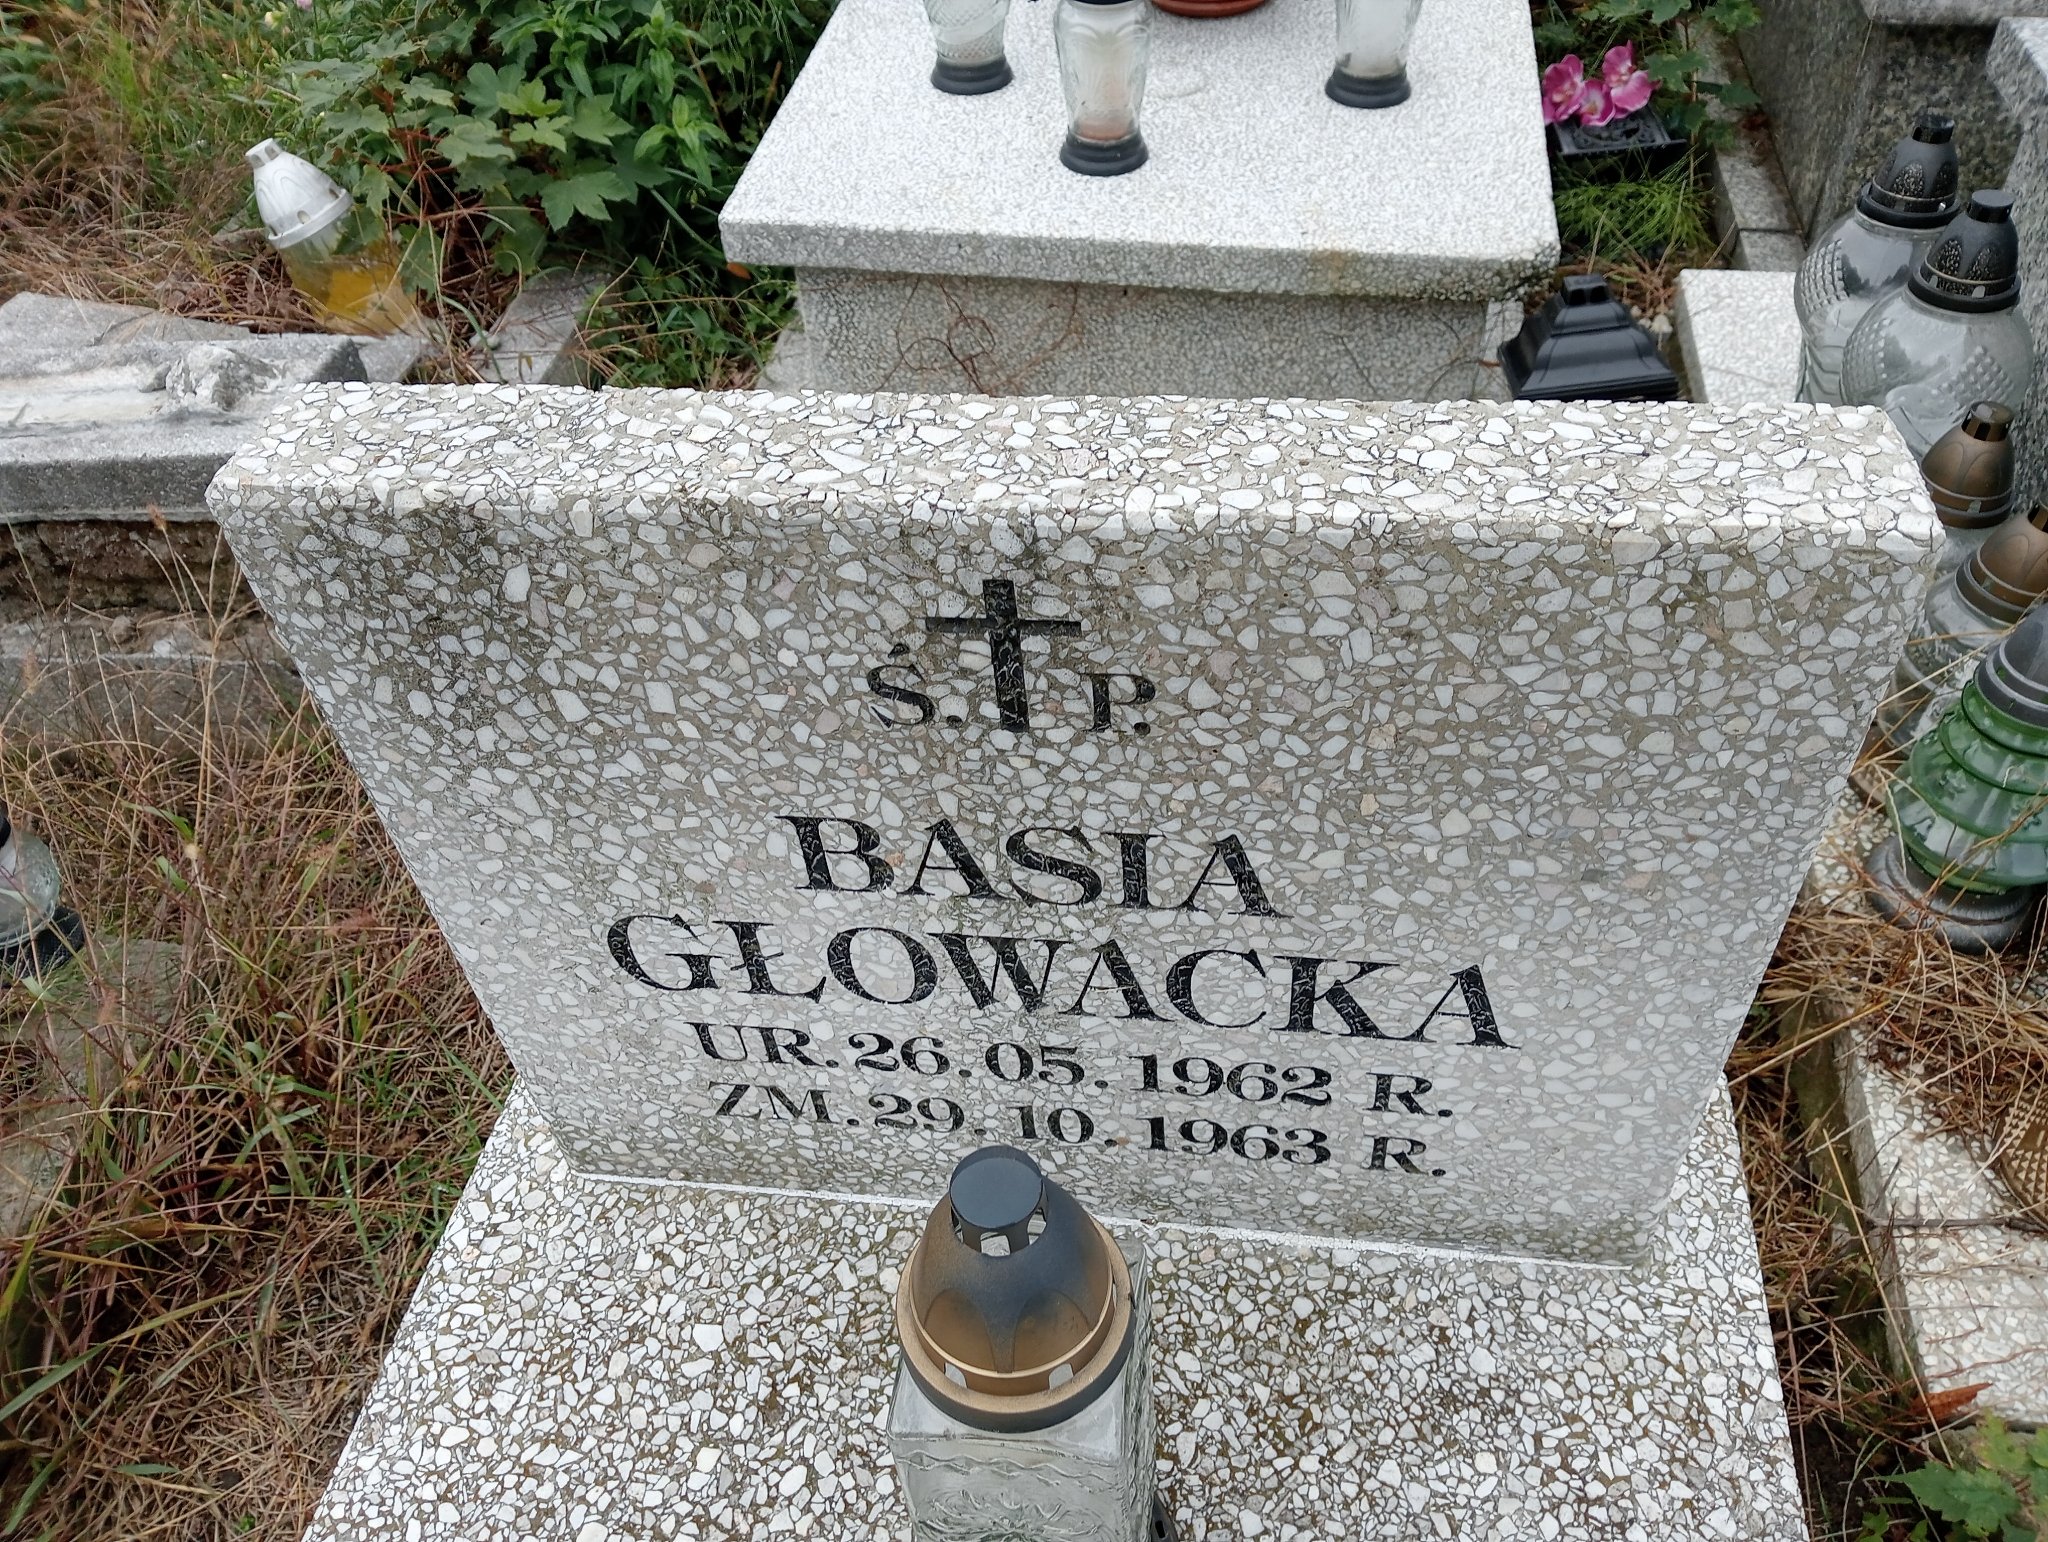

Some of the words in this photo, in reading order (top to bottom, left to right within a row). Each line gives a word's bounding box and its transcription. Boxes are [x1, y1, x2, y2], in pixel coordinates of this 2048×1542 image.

[1079, 671, 1156, 735] P.
[775, 814, 1294, 919] BASIA
[607, 914, 1522, 1050] GŁOWACKA
[1362, 1072, 1453, 1118] R.
[1361, 1136, 1447, 1177] R.
